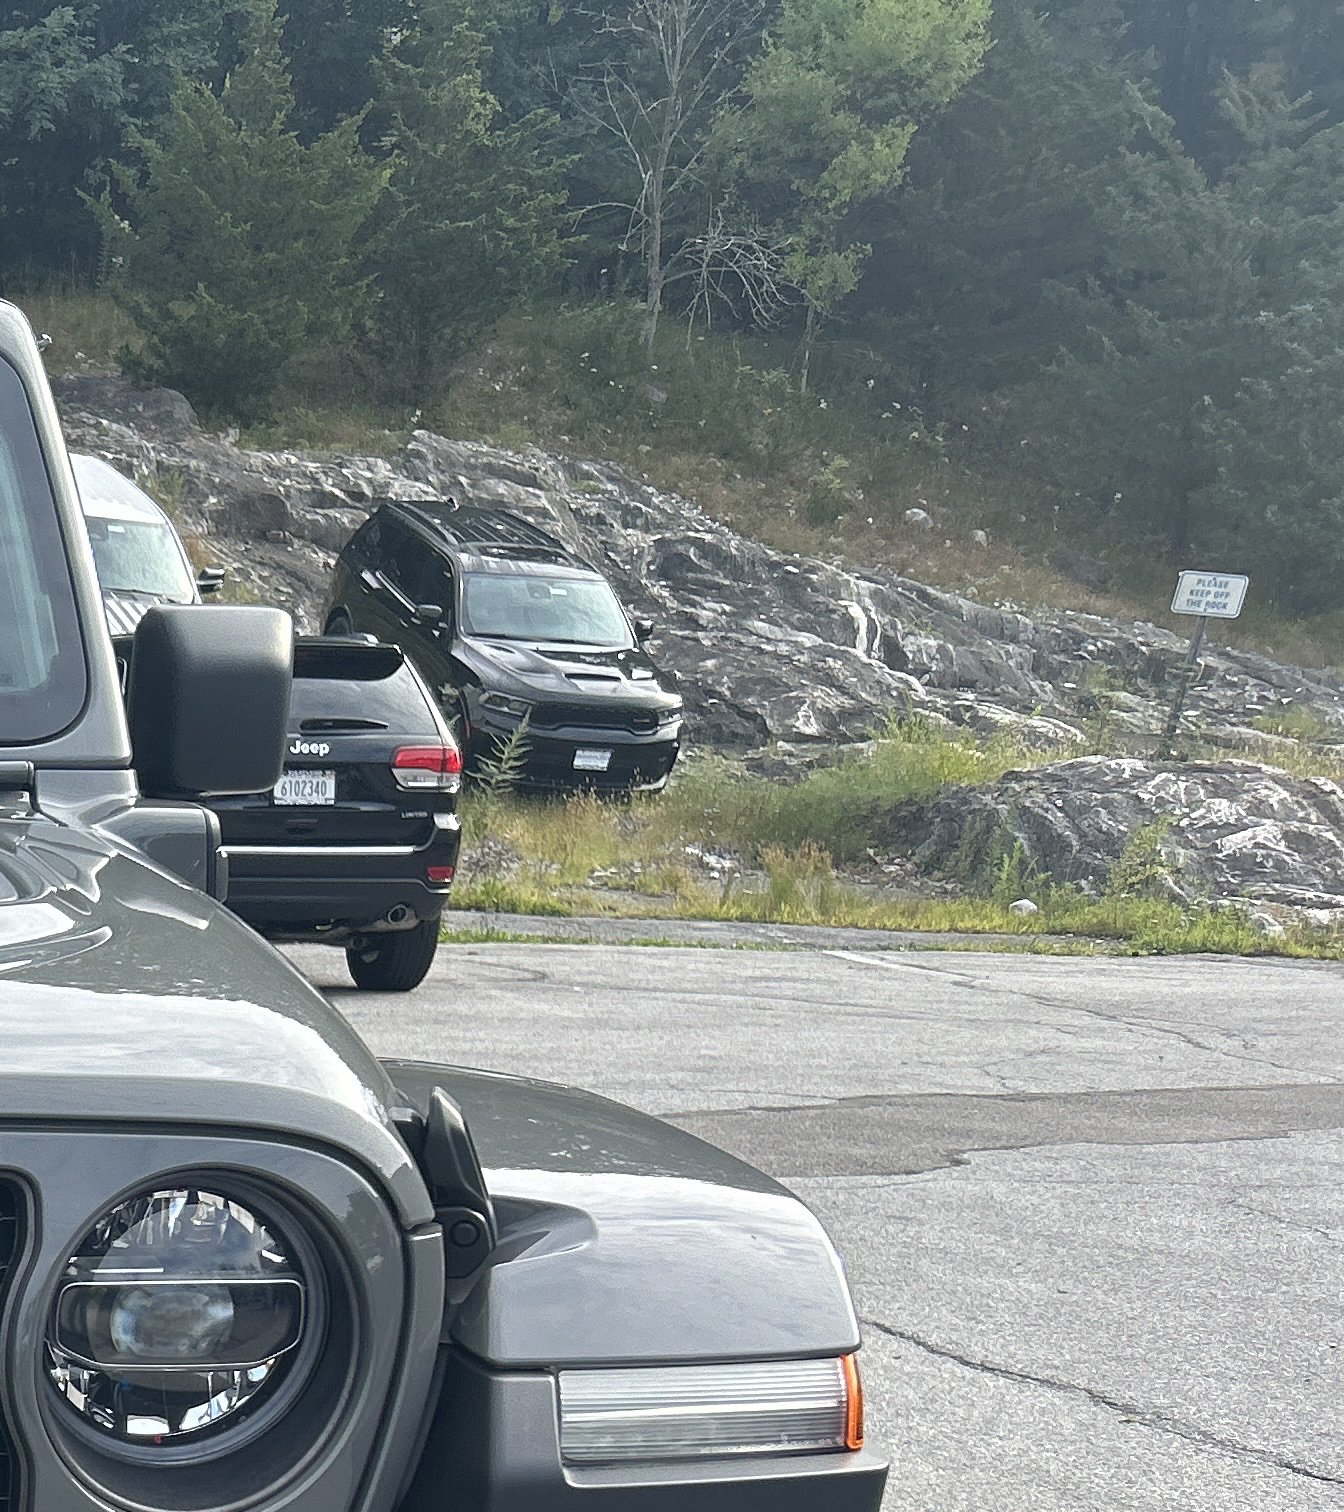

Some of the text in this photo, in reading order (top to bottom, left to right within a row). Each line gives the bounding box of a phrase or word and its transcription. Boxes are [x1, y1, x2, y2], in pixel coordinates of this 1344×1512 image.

[1189, 589, 1230, 600] KEEP OFF
[1185, 599, 1202, 608] THE
[289, 740, 330, 757] Jeep
